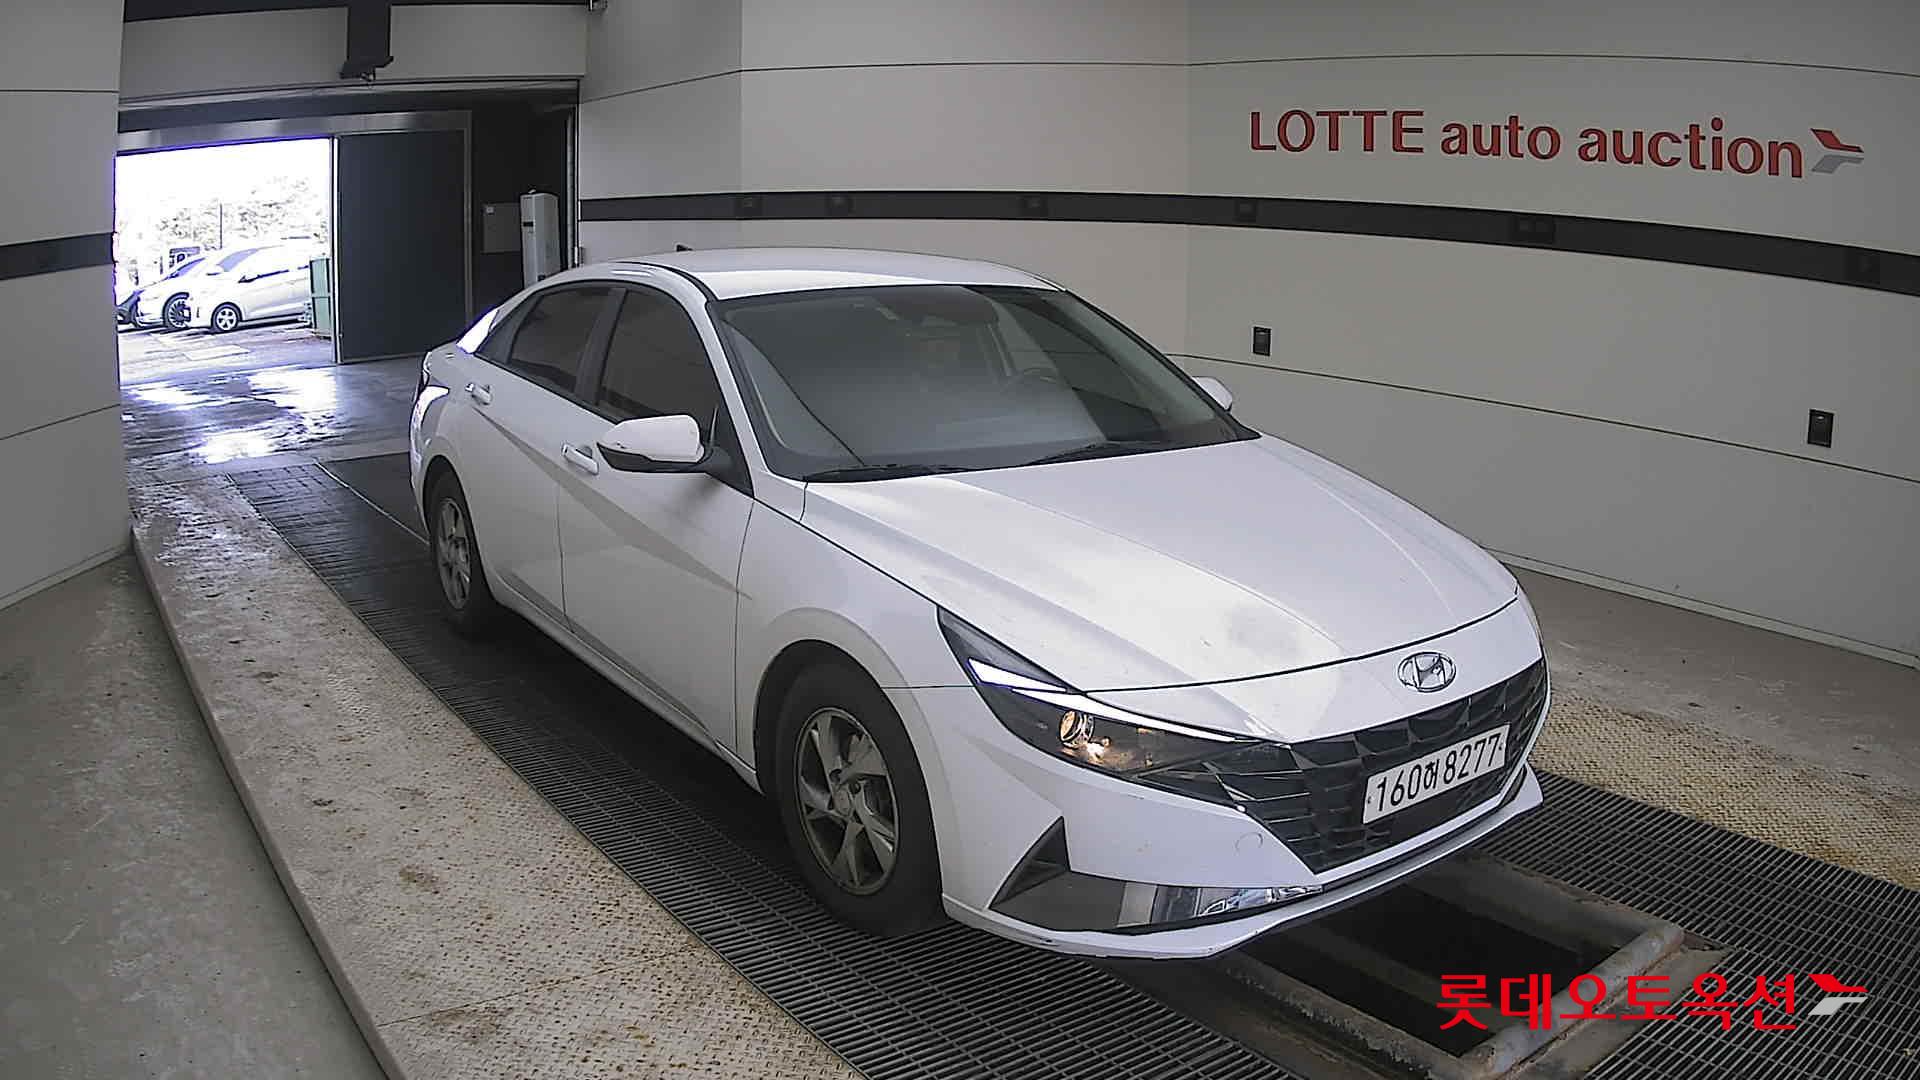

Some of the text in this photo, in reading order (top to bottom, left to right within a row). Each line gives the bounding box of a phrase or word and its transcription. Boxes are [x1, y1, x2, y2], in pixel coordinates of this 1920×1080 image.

[1249, 110, 1804, 179] LOTTE auto auction
